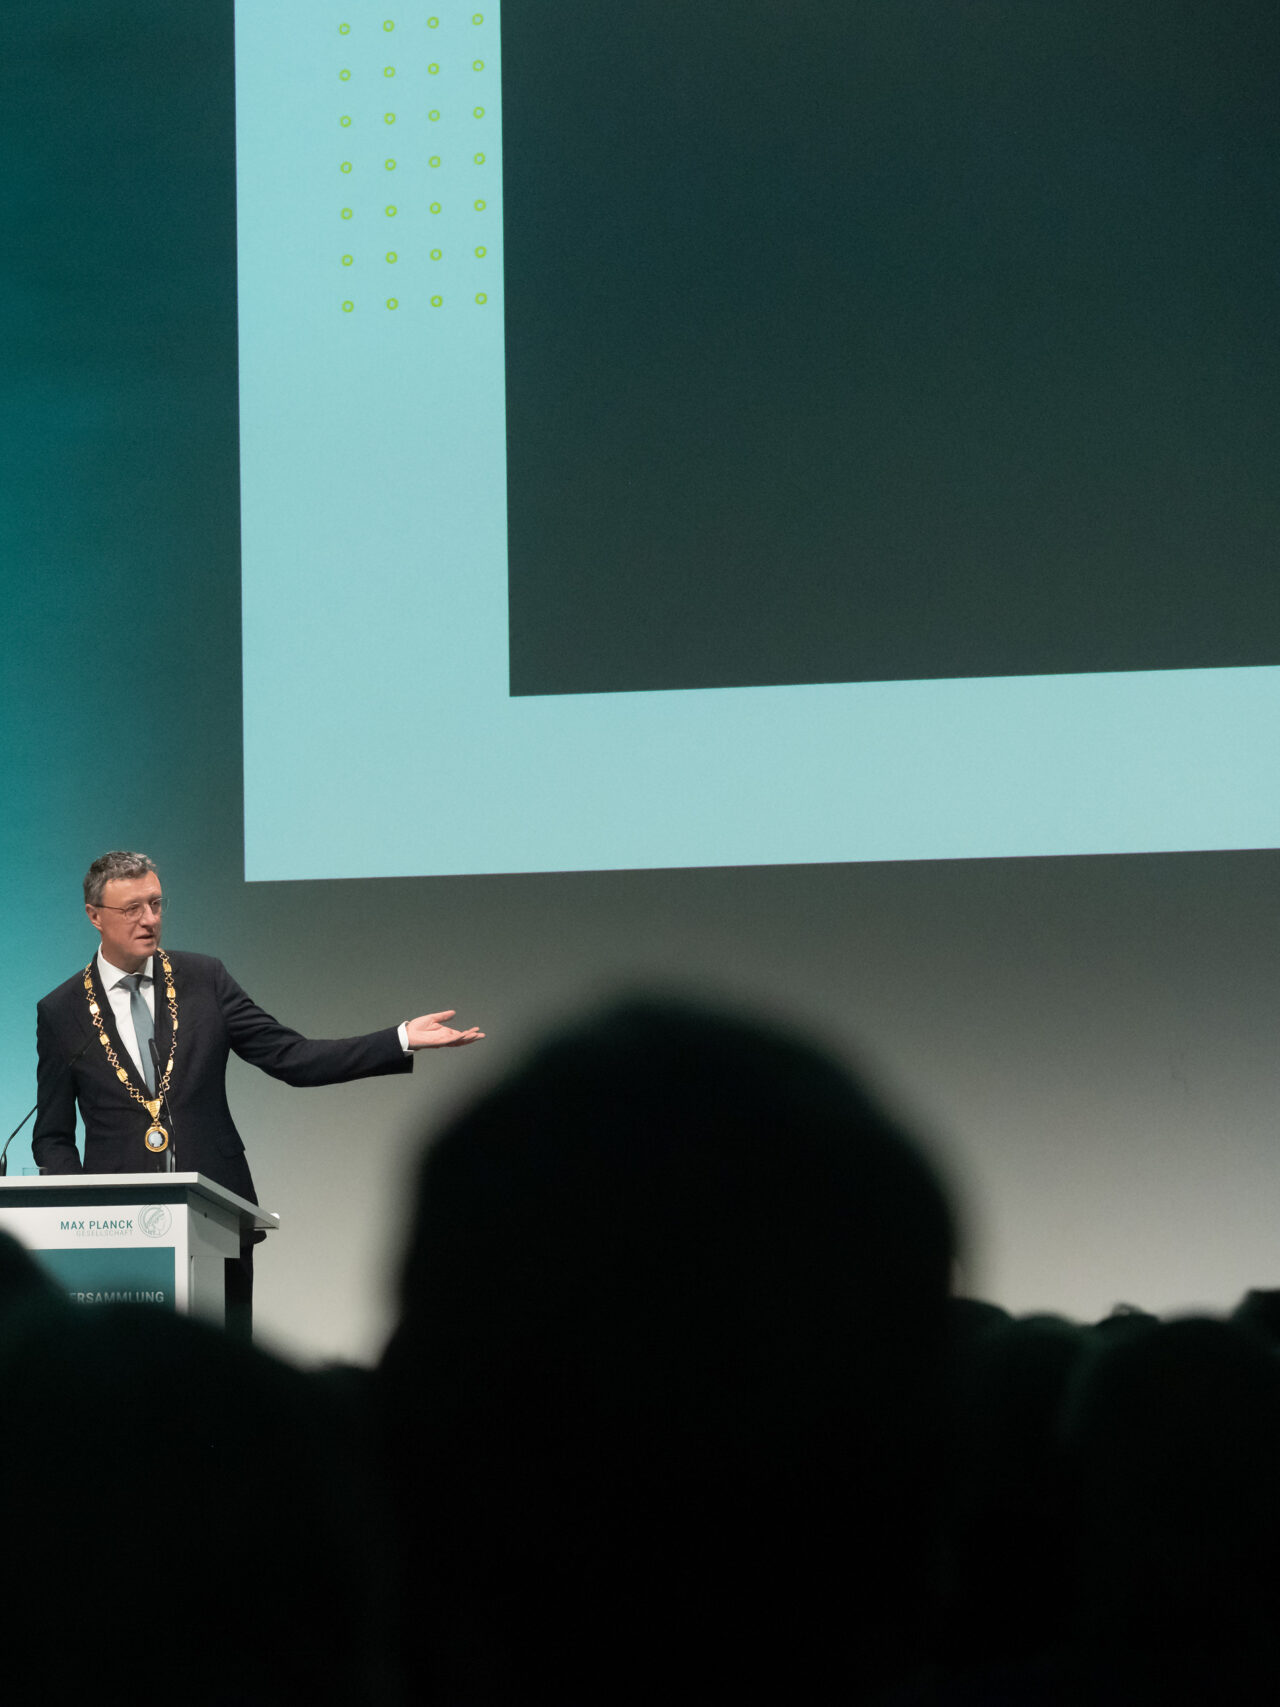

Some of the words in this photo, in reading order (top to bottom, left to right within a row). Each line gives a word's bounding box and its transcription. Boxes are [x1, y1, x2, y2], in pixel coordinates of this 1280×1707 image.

[60, 1220, 85, 1230] MAX
[89, 1219, 134, 1230] PLANCK
[69, 1291, 165, 1304] ERSAMMLUNG
